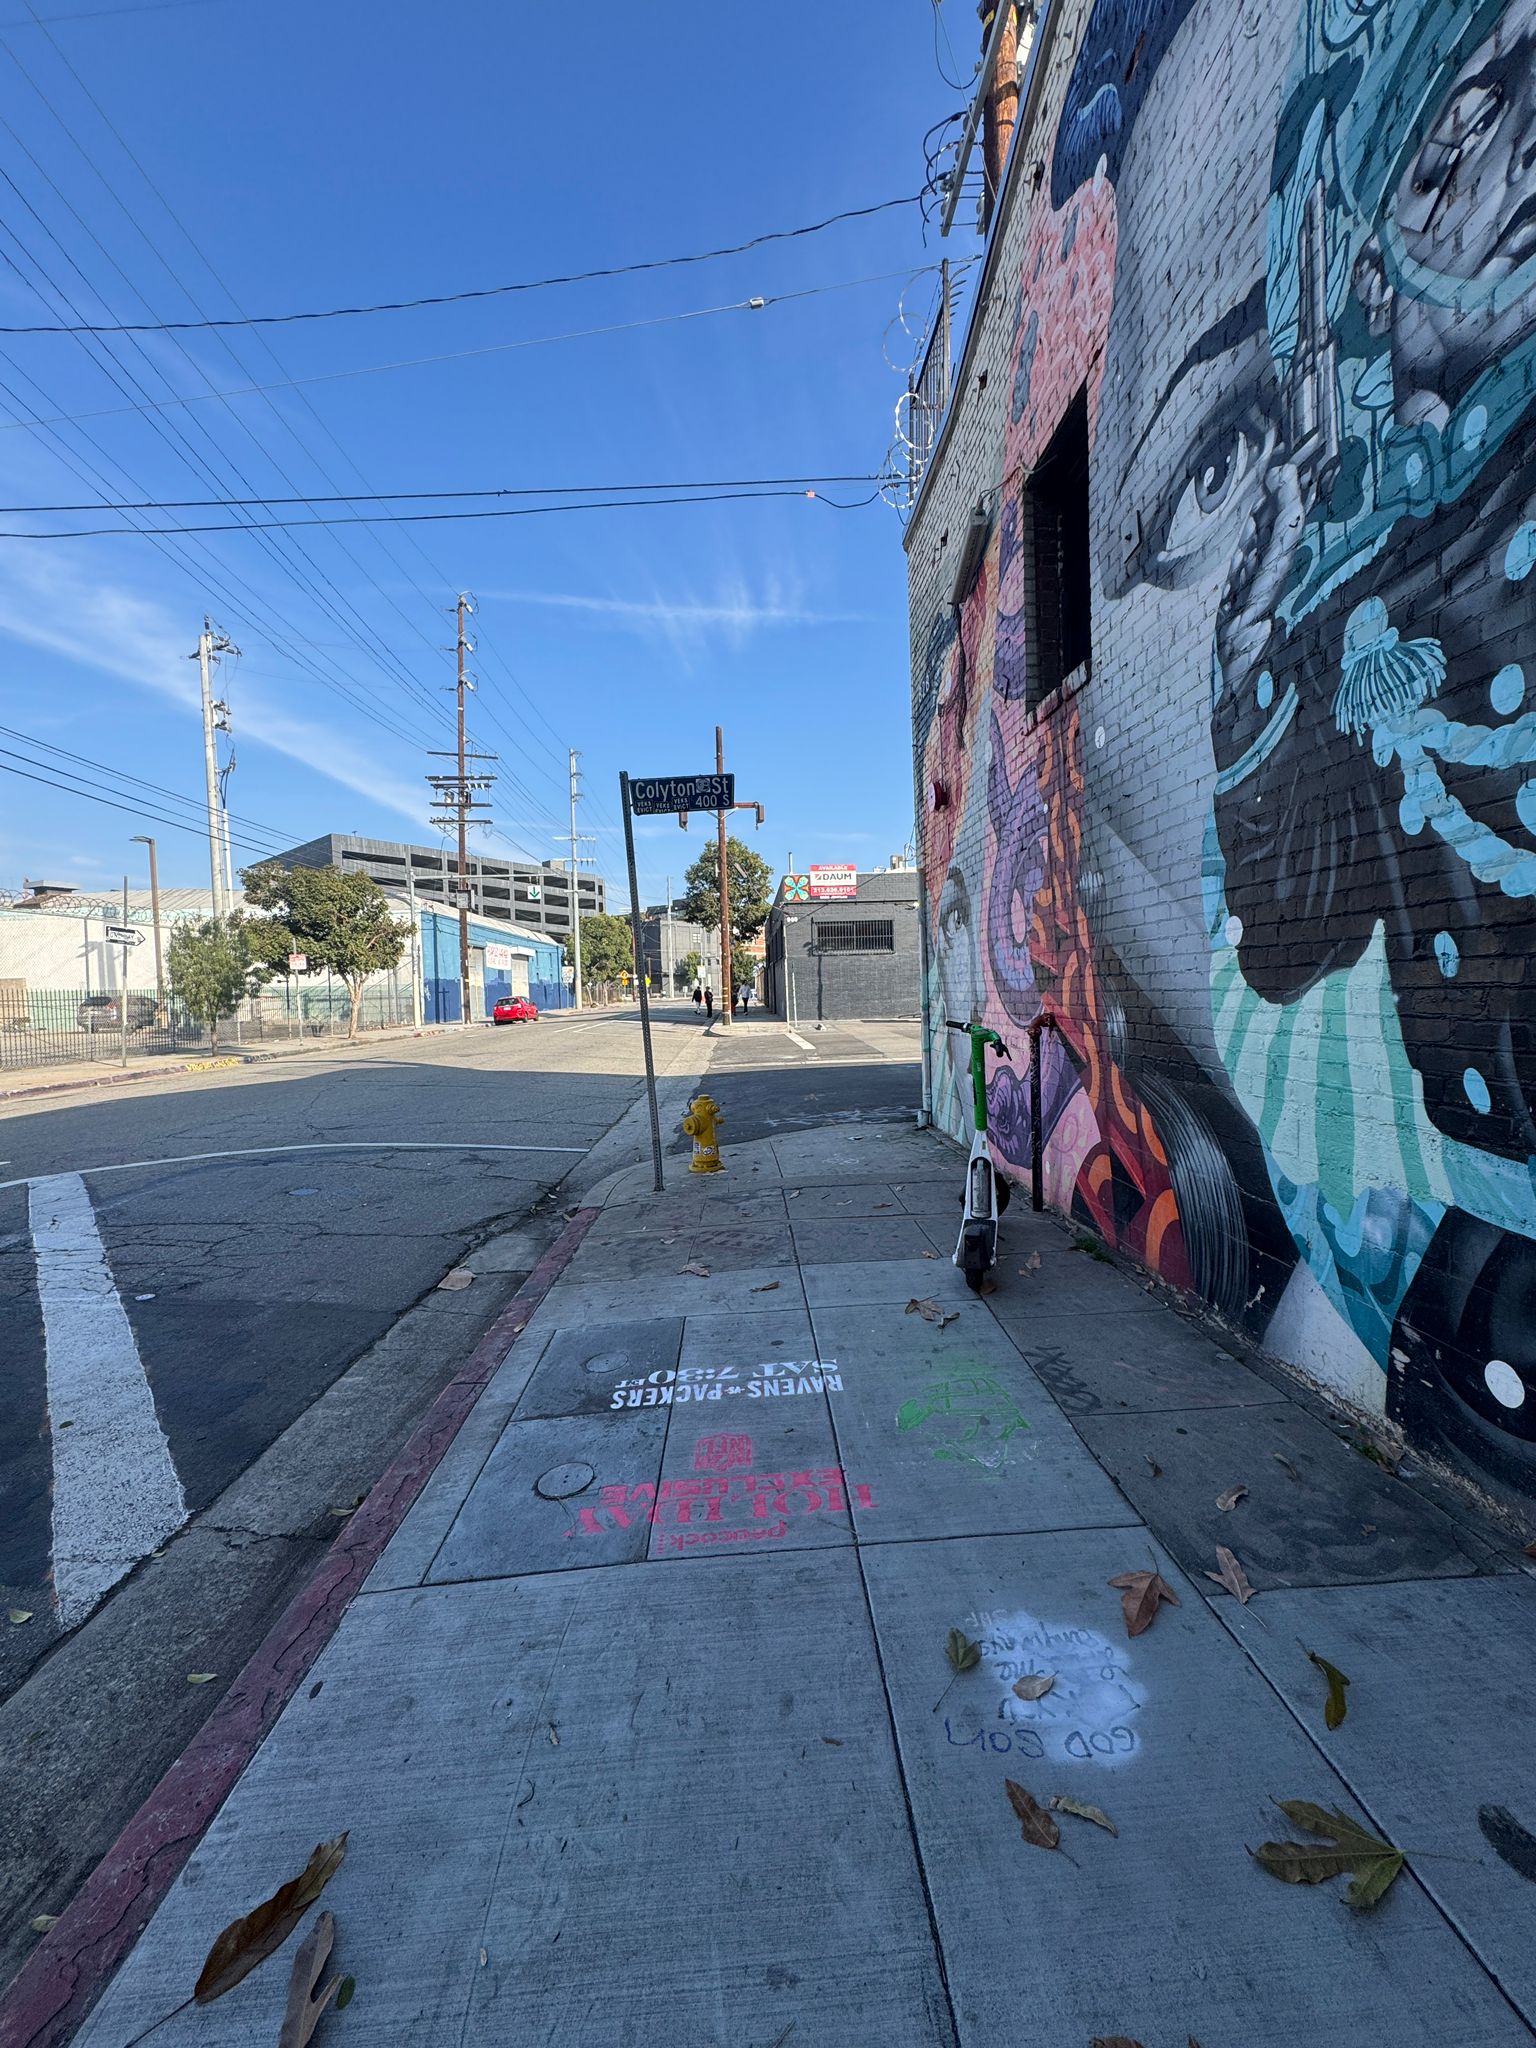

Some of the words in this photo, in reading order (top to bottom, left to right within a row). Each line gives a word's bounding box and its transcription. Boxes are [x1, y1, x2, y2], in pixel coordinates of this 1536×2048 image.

[635, 781, 695, 802] Colyton
[712, 777, 729, 794] St
[695, 795, 718, 808] 400
[722, 794, 730, 806] S
[647, 1365, 740, 1385] 7:30
[752, 1358, 839, 1378] SAT
[610, 1384, 722, 1409] PACKERS
[748, 1374, 844, 1398] RAVENS
[601, 1468, 844, 1505] EXCLUSIVE
[562, 1485, 878, 1536] HOLIDAY
[672, 1520, 787, 1552] peacock
